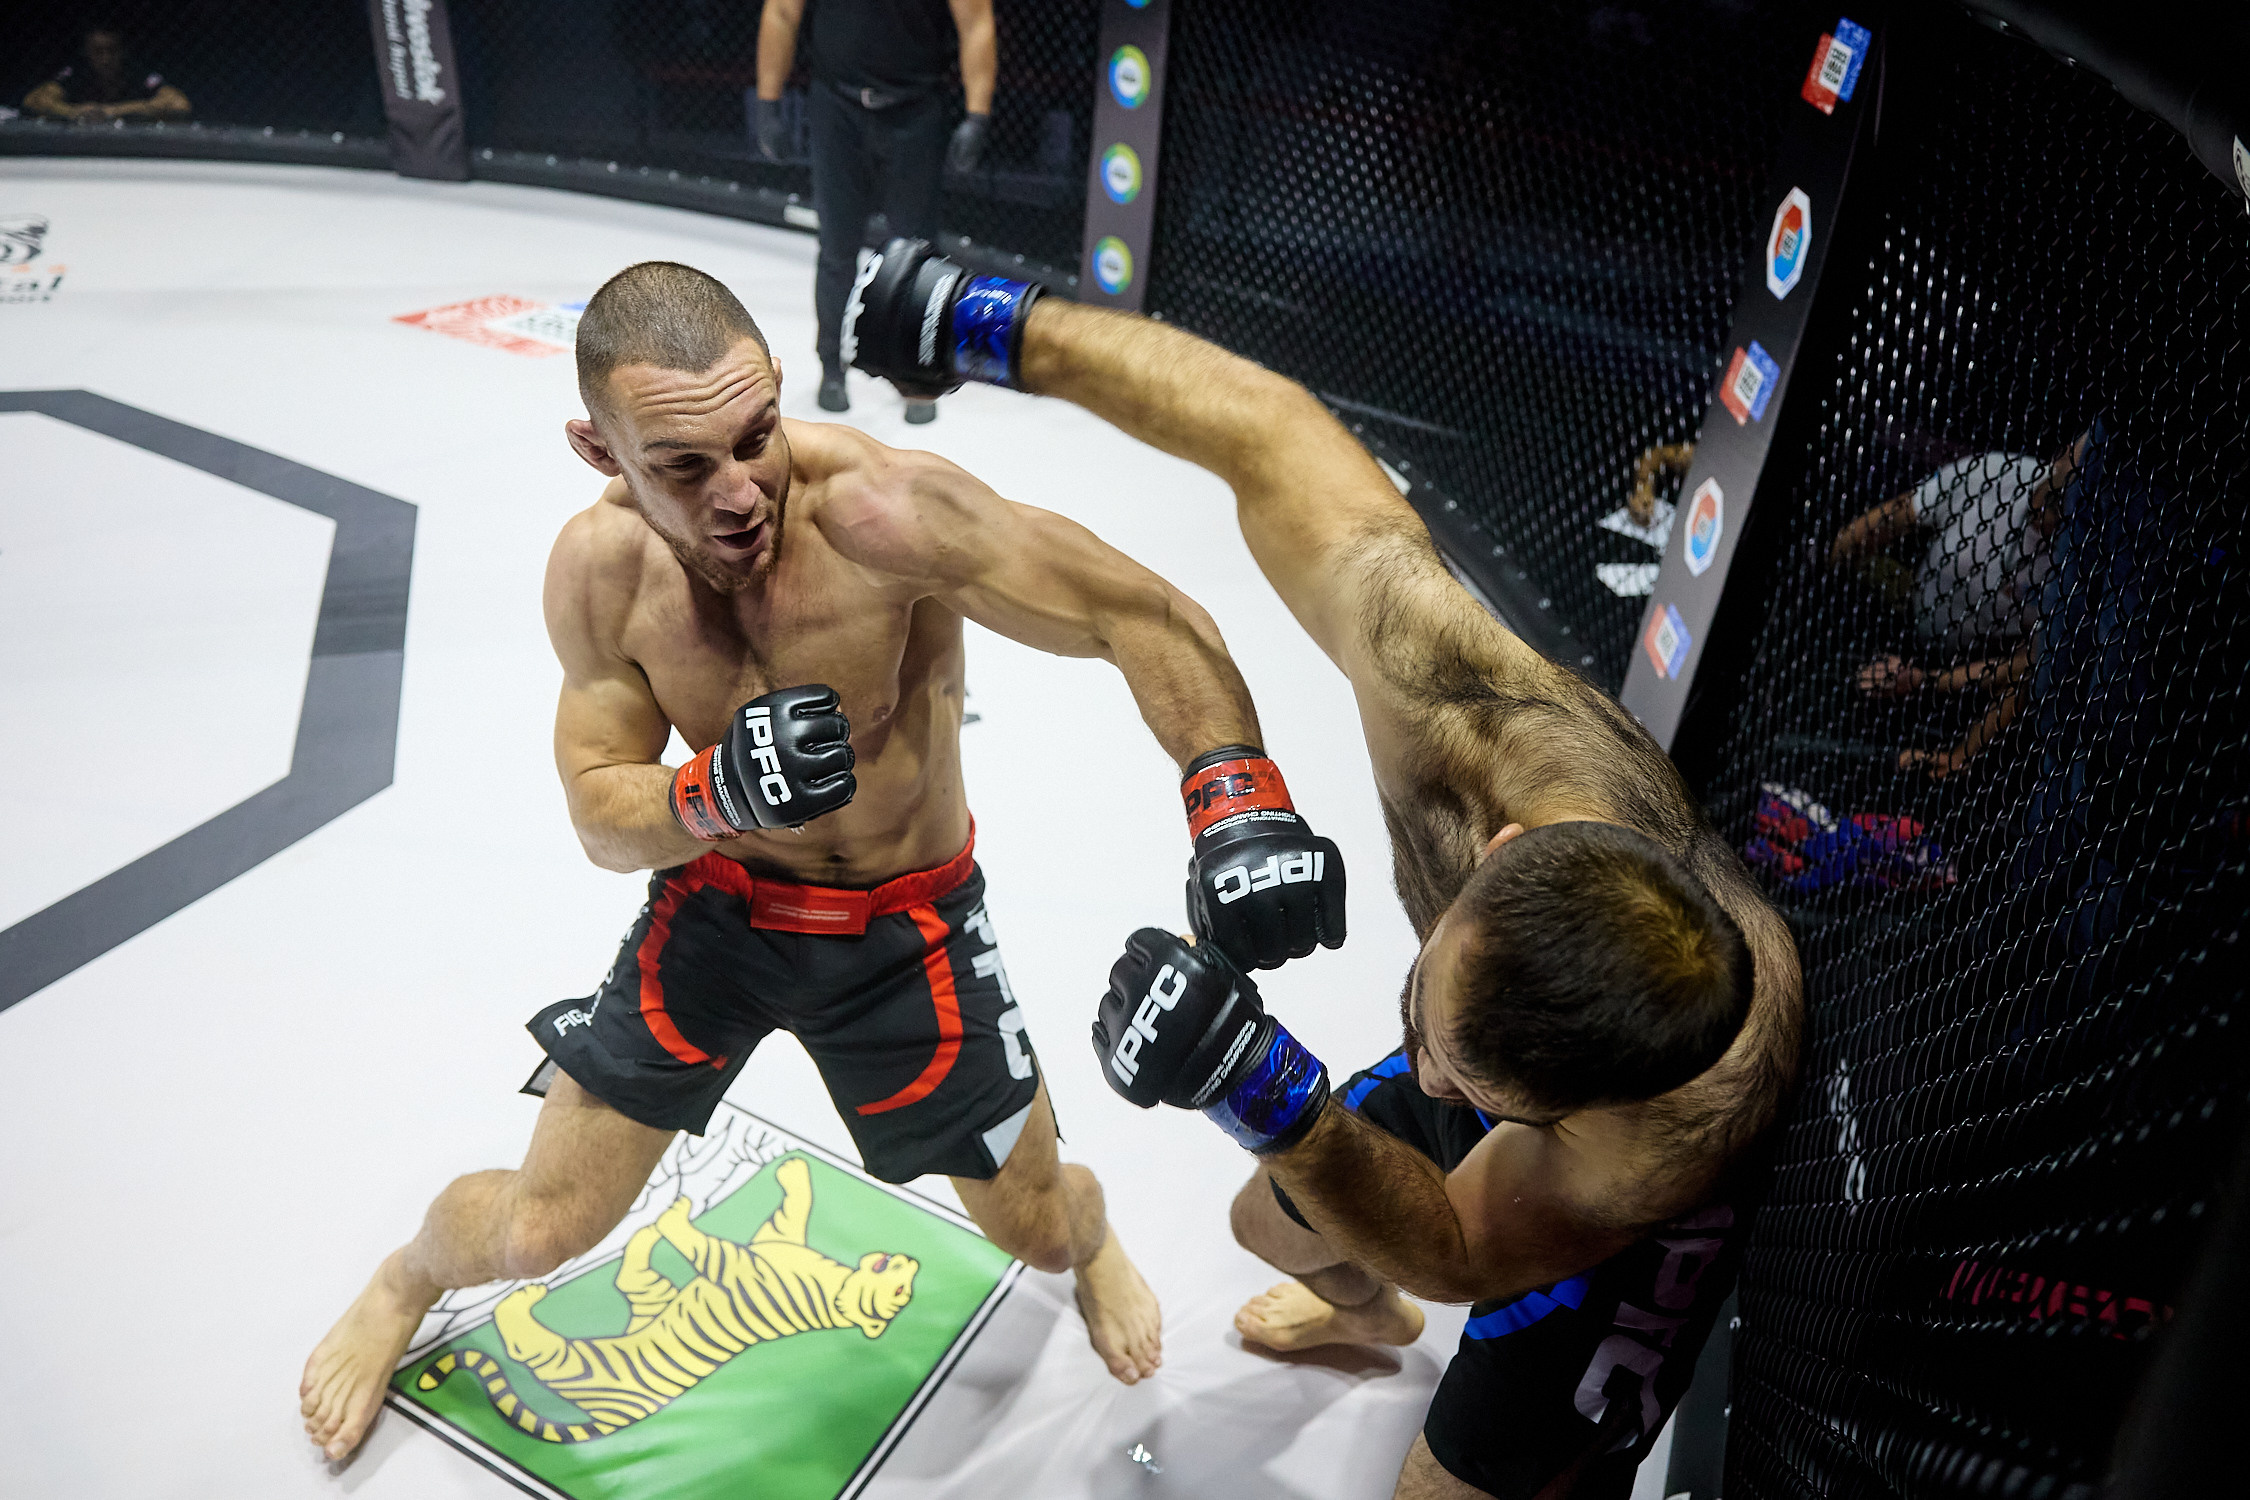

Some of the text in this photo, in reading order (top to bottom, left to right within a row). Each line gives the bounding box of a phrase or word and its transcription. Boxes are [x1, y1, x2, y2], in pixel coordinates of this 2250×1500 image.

[745, 706, 793, 806] IPFC
[1213, 851, 1325, 905] IPFC
[1110, 963, 1188, 1088] IPFC
